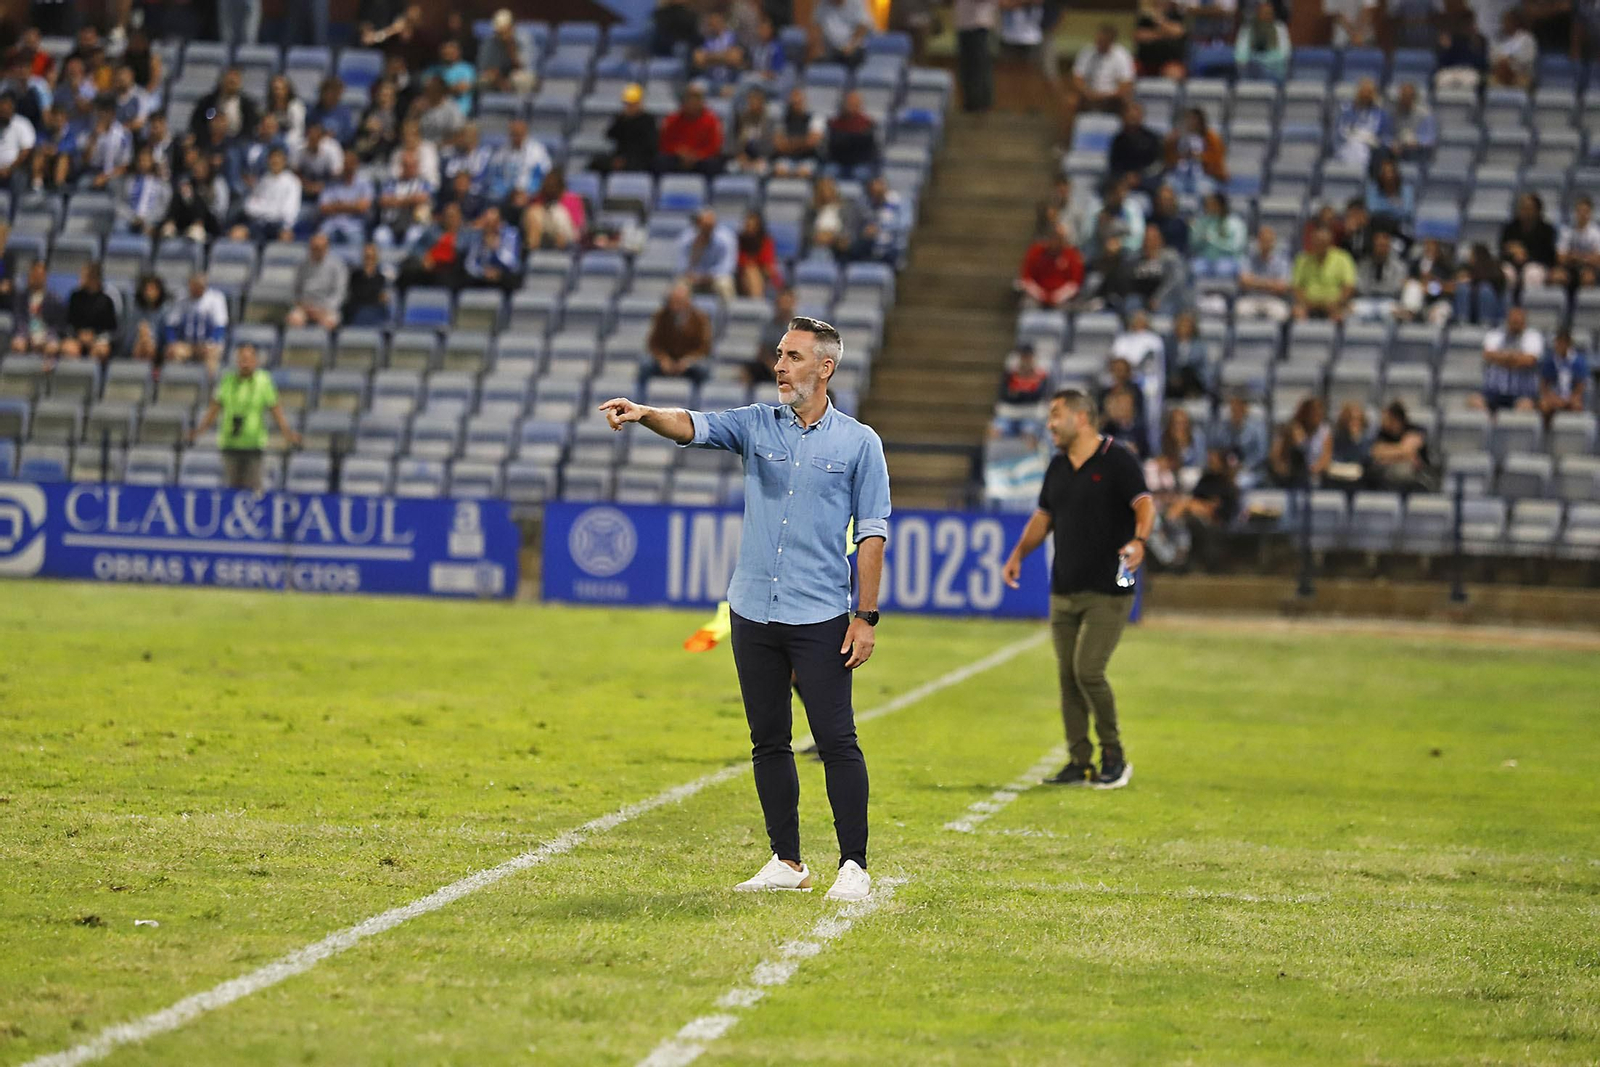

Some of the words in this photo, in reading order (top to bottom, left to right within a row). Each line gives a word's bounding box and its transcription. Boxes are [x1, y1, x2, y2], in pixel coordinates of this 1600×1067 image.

[64, 483, 415, 545] CLAU&PAUL
[93, 552, 184, 582] OBRAS
[189, 557, 209, 583] Y
